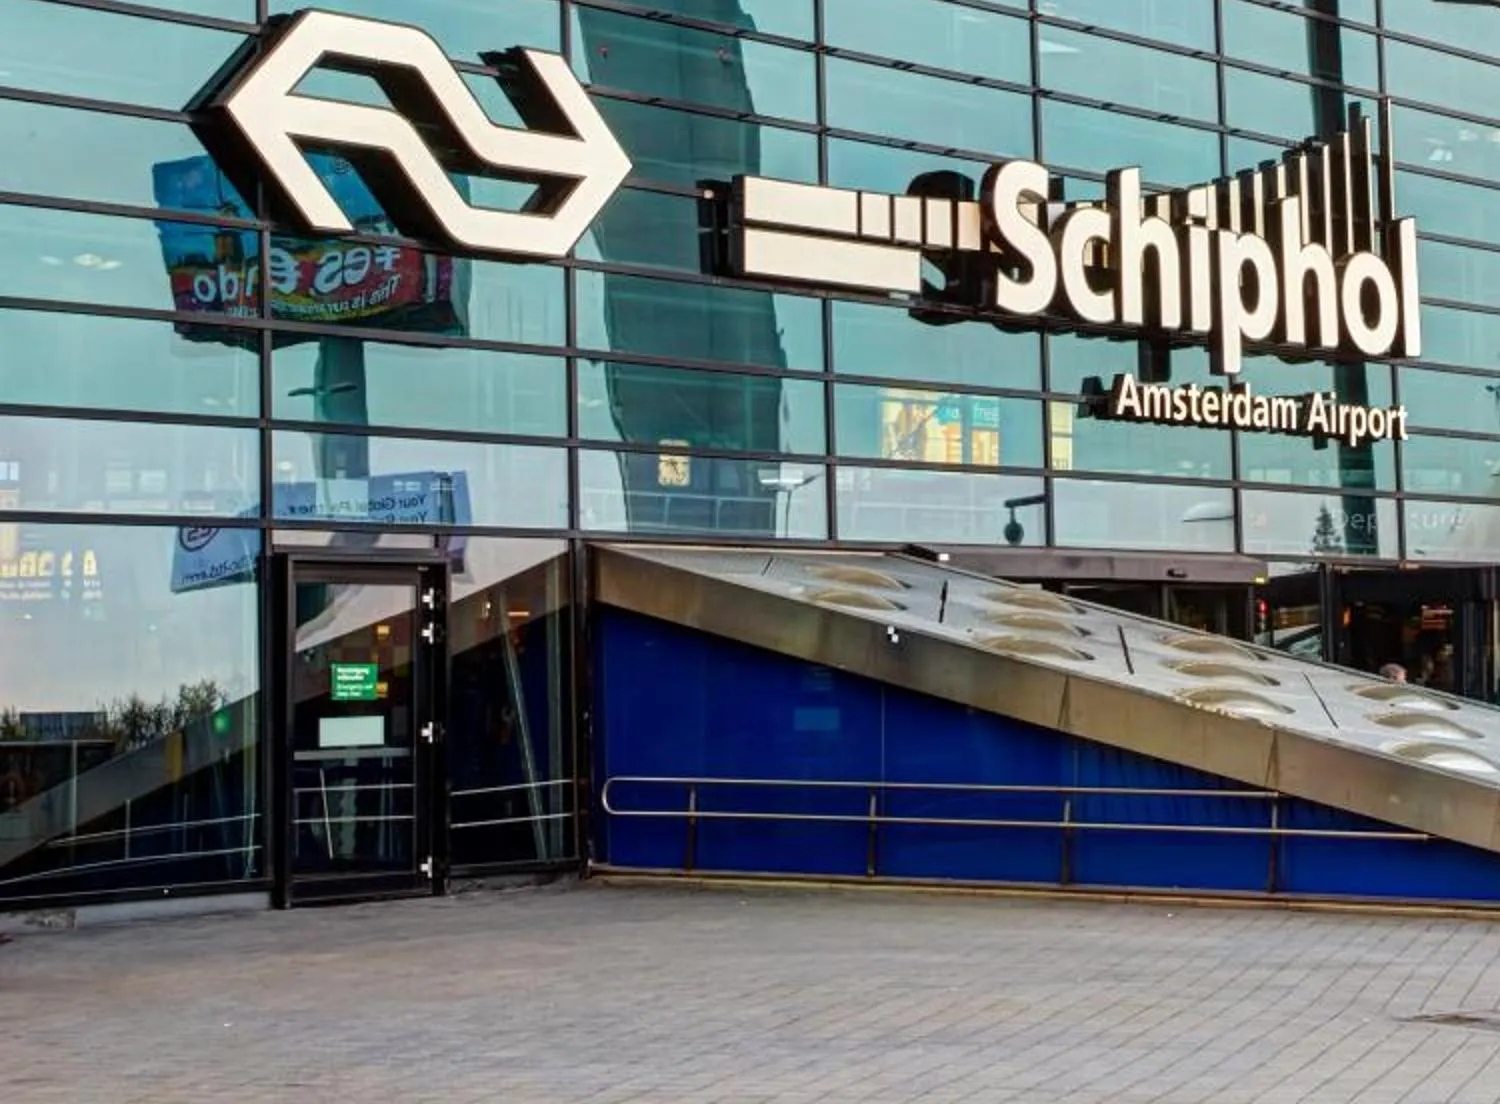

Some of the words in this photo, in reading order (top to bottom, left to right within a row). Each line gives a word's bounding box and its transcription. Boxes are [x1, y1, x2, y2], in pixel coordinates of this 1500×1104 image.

[994, 160, 1421, 374] Schiphol
[1116, 372, 1297, 430] Amsterdam
[1307, 391, 1408, 447] Airport
